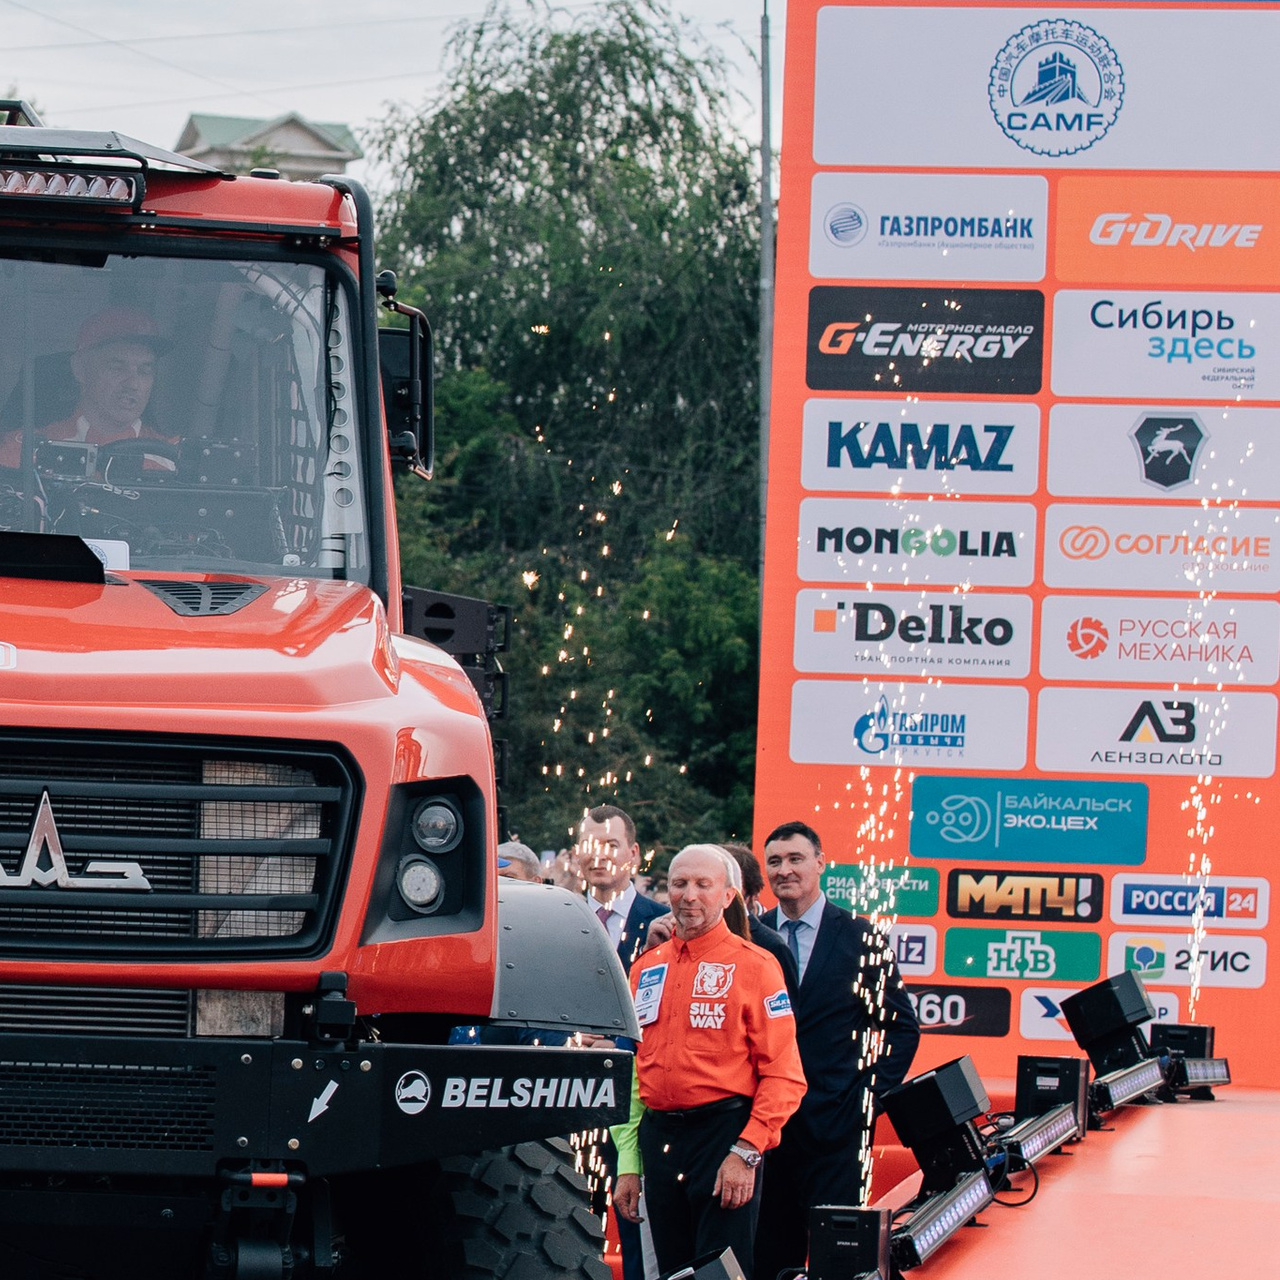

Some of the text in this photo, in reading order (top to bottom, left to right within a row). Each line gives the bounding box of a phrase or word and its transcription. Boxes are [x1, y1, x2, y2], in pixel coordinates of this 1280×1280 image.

[1007, 113, 1104, 131] CAMF
[879, 216, 1034, 239] ГАЗПРОМБАНК
[907, 323, 1034, 335] МОТОРНОЕ МАСЛО
[1090, 300, 1235, 337] Сибирь
[1148, 336, 1256, 363] здесь
[827, 421, 1015, 472] KAMAZ
[816, 526, 1017, 558] MONGOLIA
[1115, 534, 1271, 557] СОГЛАСИЕ
[853, 602, 1014, 647] Delko
[1119, 619, 1237, 640] РУССКАЯ
[854, 655, 1011, 666] ТРАНПОРТНАЯ КОМПАНИЯ
[1117, 642, 1254, 663] МЕХАНИКА
[889, 747, 965, 757] ИРКУТСК
[1090, 751, 1222, 766] ЛЕНЗОЛОТО
[1004, 792, 1133, 813] БАЙКАЛЬСК
[1003, 814, 1099, 831] ЭКО.ЦЕХ
[826, 876, 856, 888] РИА
[957, 874, 1093, 918] МАТЧ!
[1130, 889, 1255, 913] РОССИЯ 24
[991, 933, 1053, 976] НТВ
[689, 1002, 726, 1017] SILK
[689, 1016, 726, 1030] WAY
[441, 1077, 616, 1109] BELSHINA
